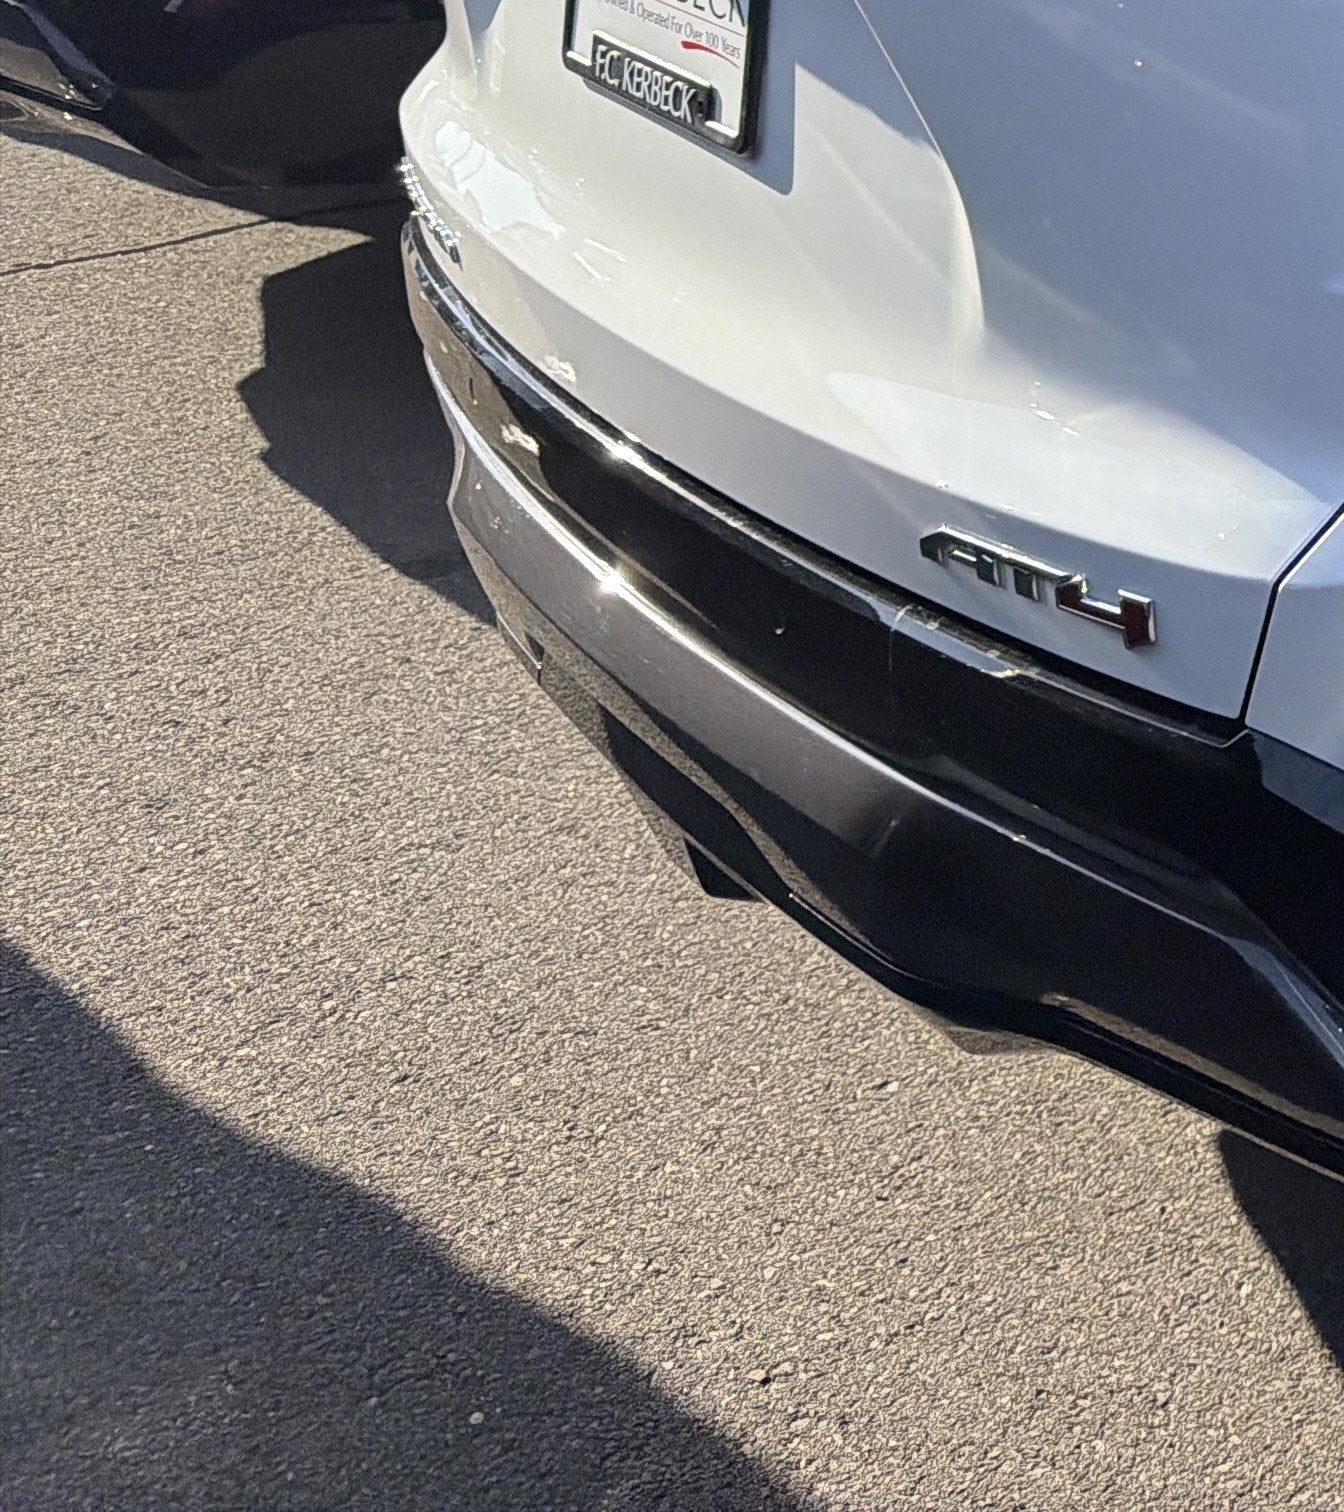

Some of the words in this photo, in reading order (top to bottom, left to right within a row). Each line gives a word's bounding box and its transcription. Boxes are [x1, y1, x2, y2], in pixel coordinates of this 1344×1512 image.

[637, 2, 670, 29] Operated
[671, 15, 683, 33] For
[684, 22, 703, 42] Over
[705, 30, 720, 49] 100
[721, 36, 741, 59] Years
[622, 57, 696, 124] KERBECK
[920, 522, 1157, 649] AT4
